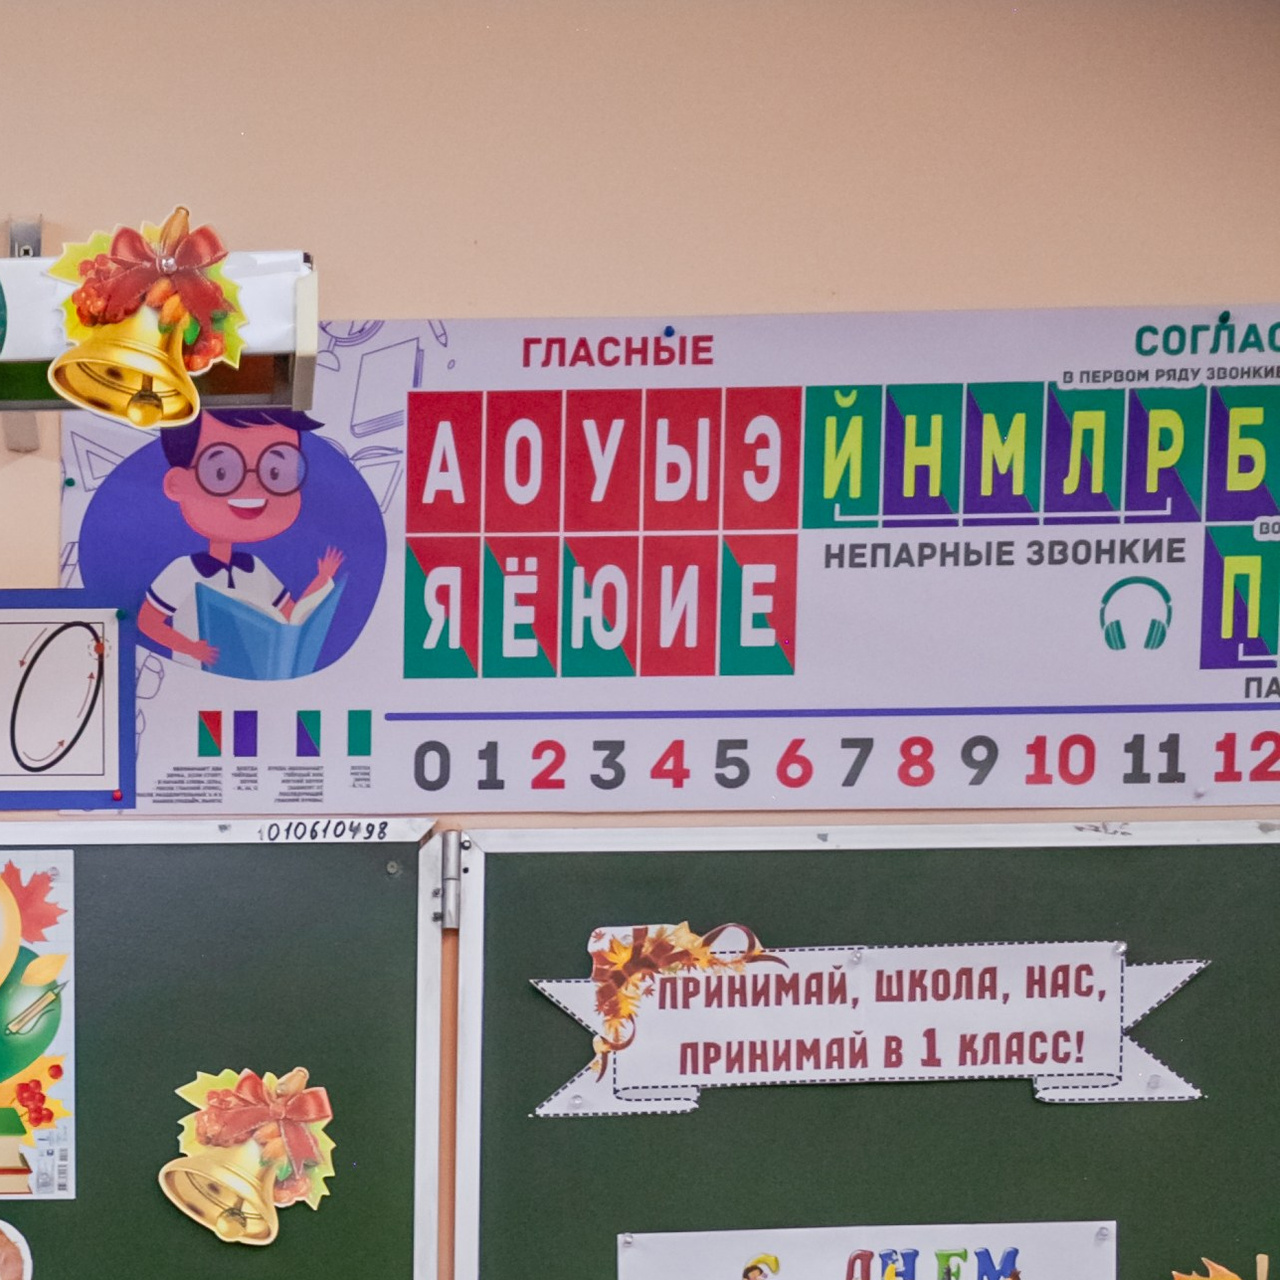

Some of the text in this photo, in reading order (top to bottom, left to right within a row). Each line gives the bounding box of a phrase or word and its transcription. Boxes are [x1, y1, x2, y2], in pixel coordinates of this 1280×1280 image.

[522, 335, 715, 368] ГЛАСНЫЕ
[1063, 370, 1074, 384] В
[1080, 369, 1150, 384] ПЕРВОМ
[1155, 367, 1201, 382] РЯДУ
[421, 388, 1267, 505] А О У Ы Э Й Н М Л Р Б
[824, 537, 1187, 570] НЕПАРНЫЕ ЗВОНКИЕ
[422, 556, 777, 659] Я Ё Ю И Е
[413, 739, 451, 792] 0
[476, 740, 506, 791] 1
[529, 739, 567, 791] 2
[590, 739, 627, 791] 3
[650, 738, 690, 789] 4
[713, 738, 751, 790] 5
[775, 738, 813, 789] 6
[840, 737, 875, 788] 7
[897, 735, 936, 788] 8
[961, 735, 999, 787] 9
[1025, 733, 1096, 786] 10
[1123, 733, 1186, 785] 11
[657, 962, 1107, 1012] ПРИНИМАЙ, ШКОЛА, НАС,
[678, 1026, 1087, 1076] ПРИНИМАЙ В 1 КЛАСС!
